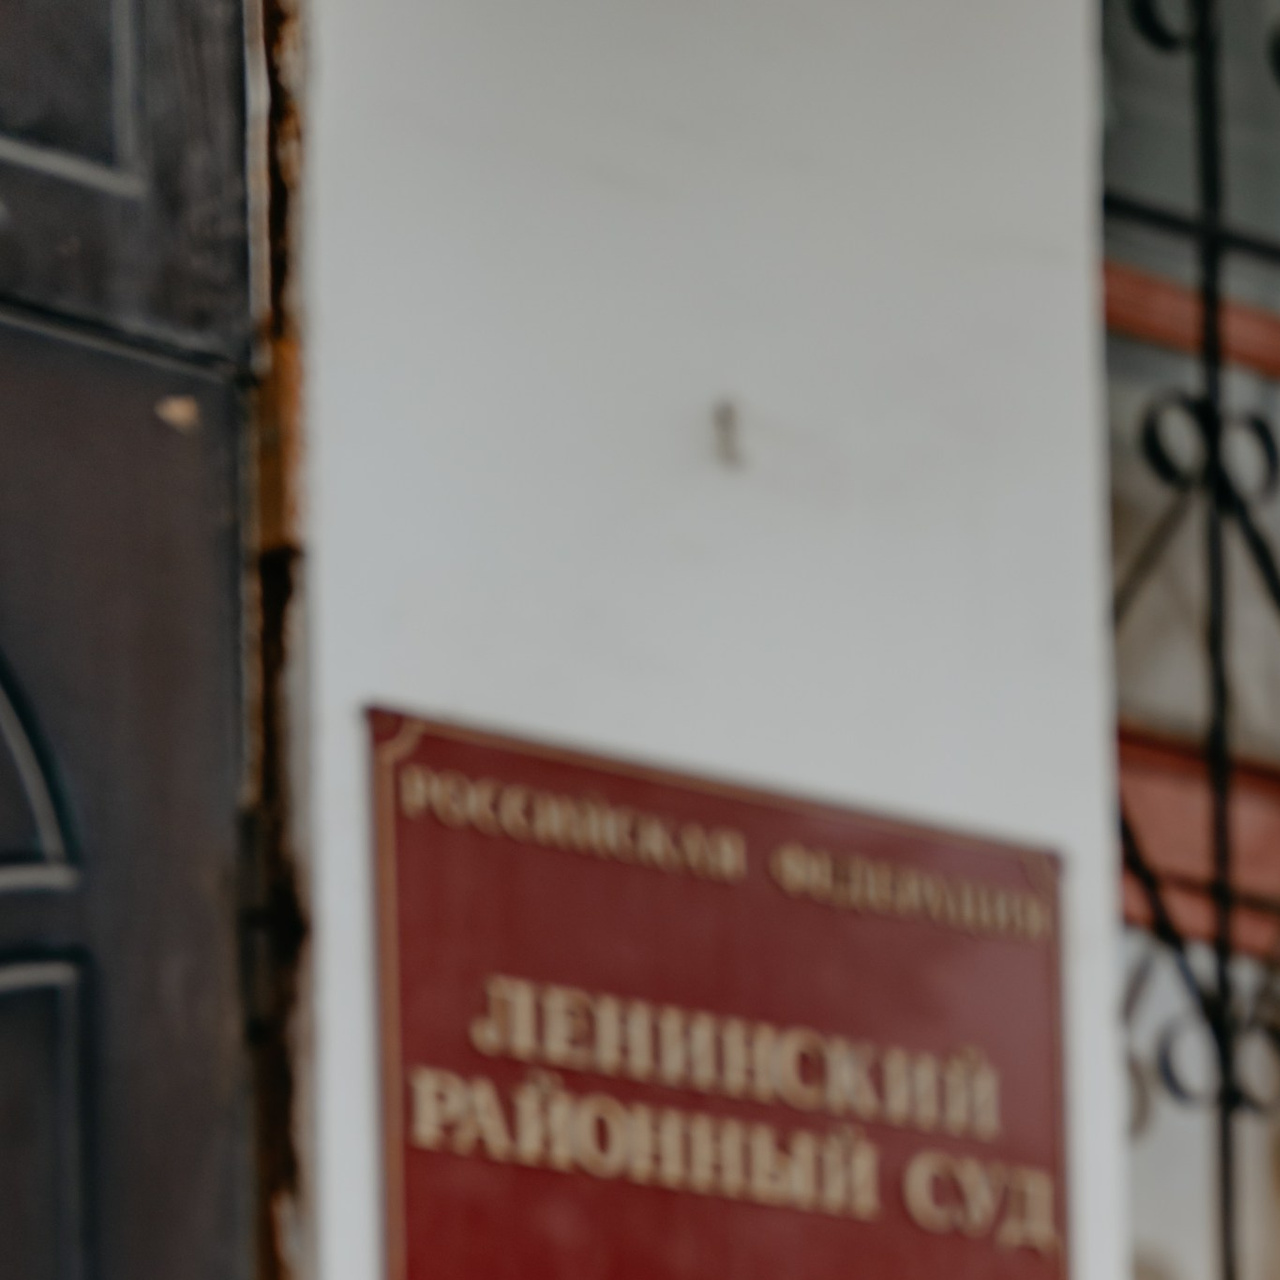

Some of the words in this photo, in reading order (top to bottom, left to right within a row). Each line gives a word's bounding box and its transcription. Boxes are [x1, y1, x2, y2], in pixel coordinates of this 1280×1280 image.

[401, 765, 746, 883] РОССИЙСКАЯ
[470, 974, 997, 1143] ЛЕНИНСКИЙ
[410, 1066, 881, 1221] РАЙОННЫЙ
[904, 1150, 1057, 1254] СУД
